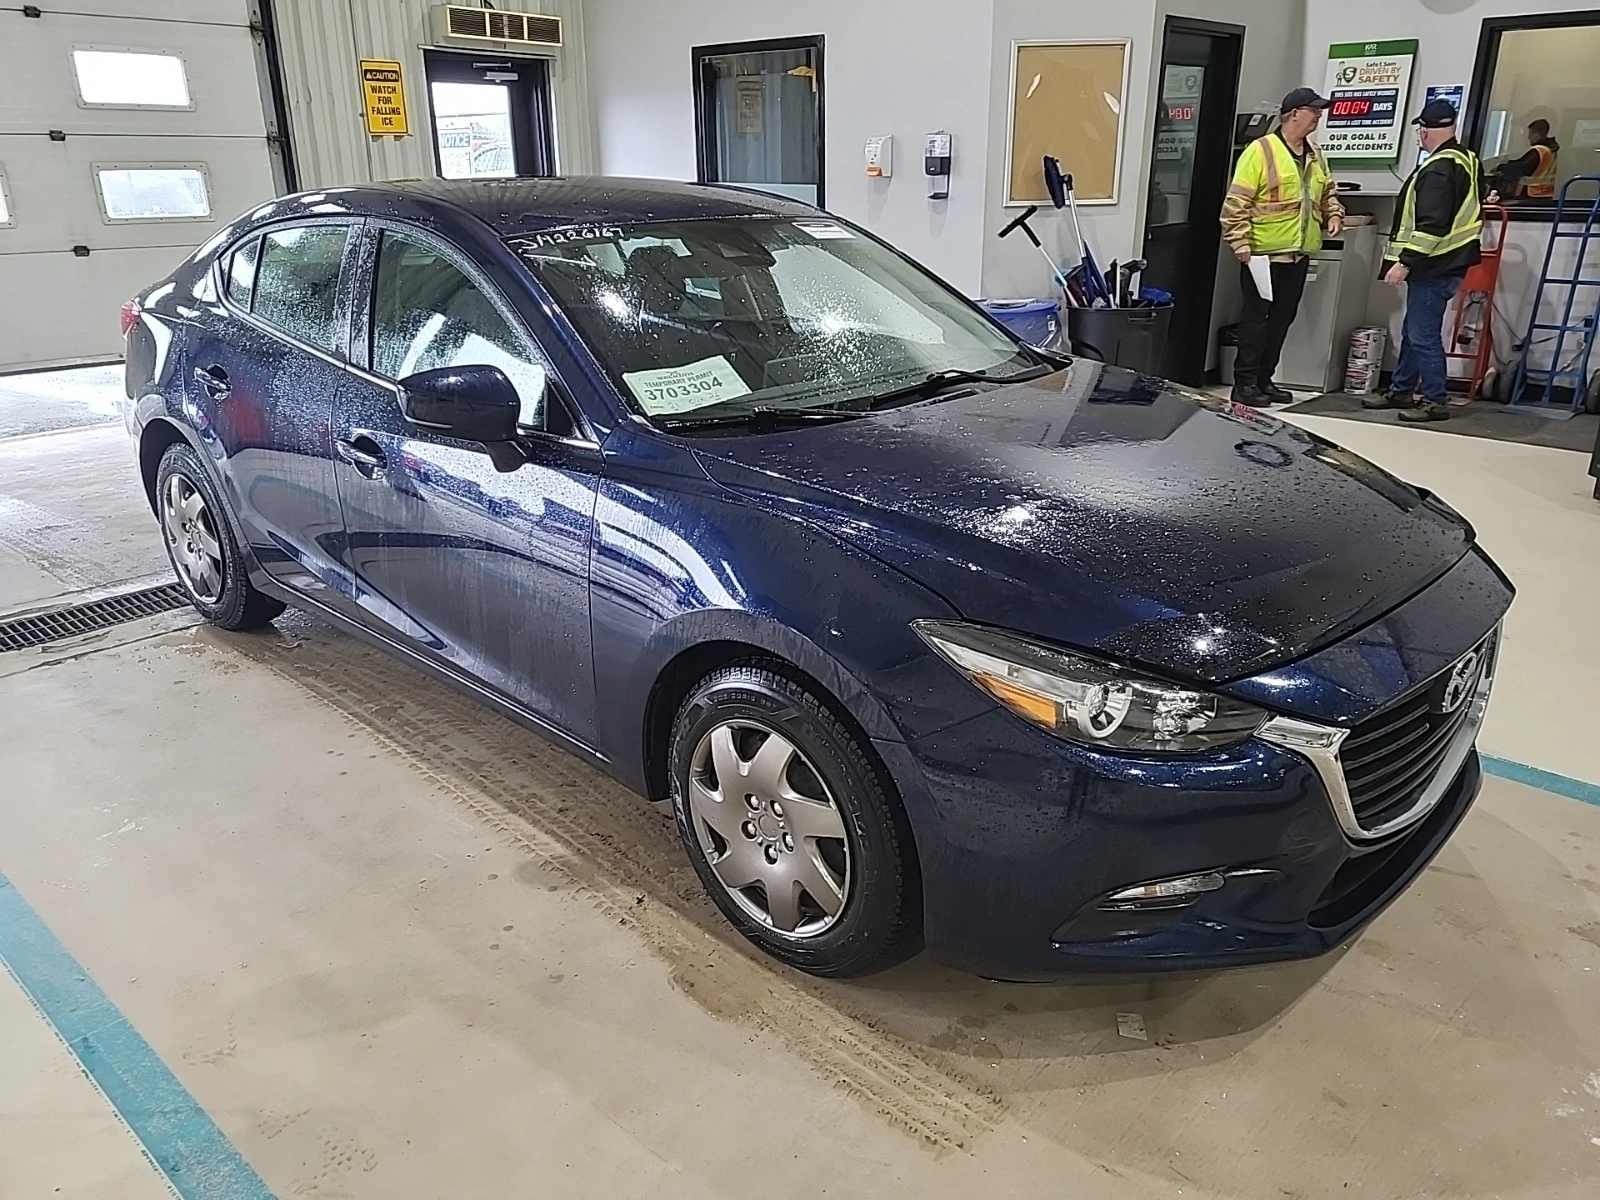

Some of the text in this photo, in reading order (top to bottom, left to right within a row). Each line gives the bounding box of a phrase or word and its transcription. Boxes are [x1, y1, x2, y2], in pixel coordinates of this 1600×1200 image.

[1345, 67, 1354, 78] S
[1390, 66, 1401, 74] BY
[372, 71, 398, 80] CAUTION
[1358, 74, 1400, 84] SAFETY
[370, 85, 397, 95] WATCH
[377, 96, 392, 105] FOR
[371, 106, 401, 116] FALLING
[1372, 102, 1393, 111] DAYS
[381, 117, 394, 126] ICE
[1329, 132, 1387, 141] OUR GOAL IS
[1320, 143, 1393, 151] ZERO ACCIDENTS
[643, 378, 686, 390] TEMPORARY
[686, 370, 714, 383] PERMIT
[643, 376, 723, 401] 3703304
